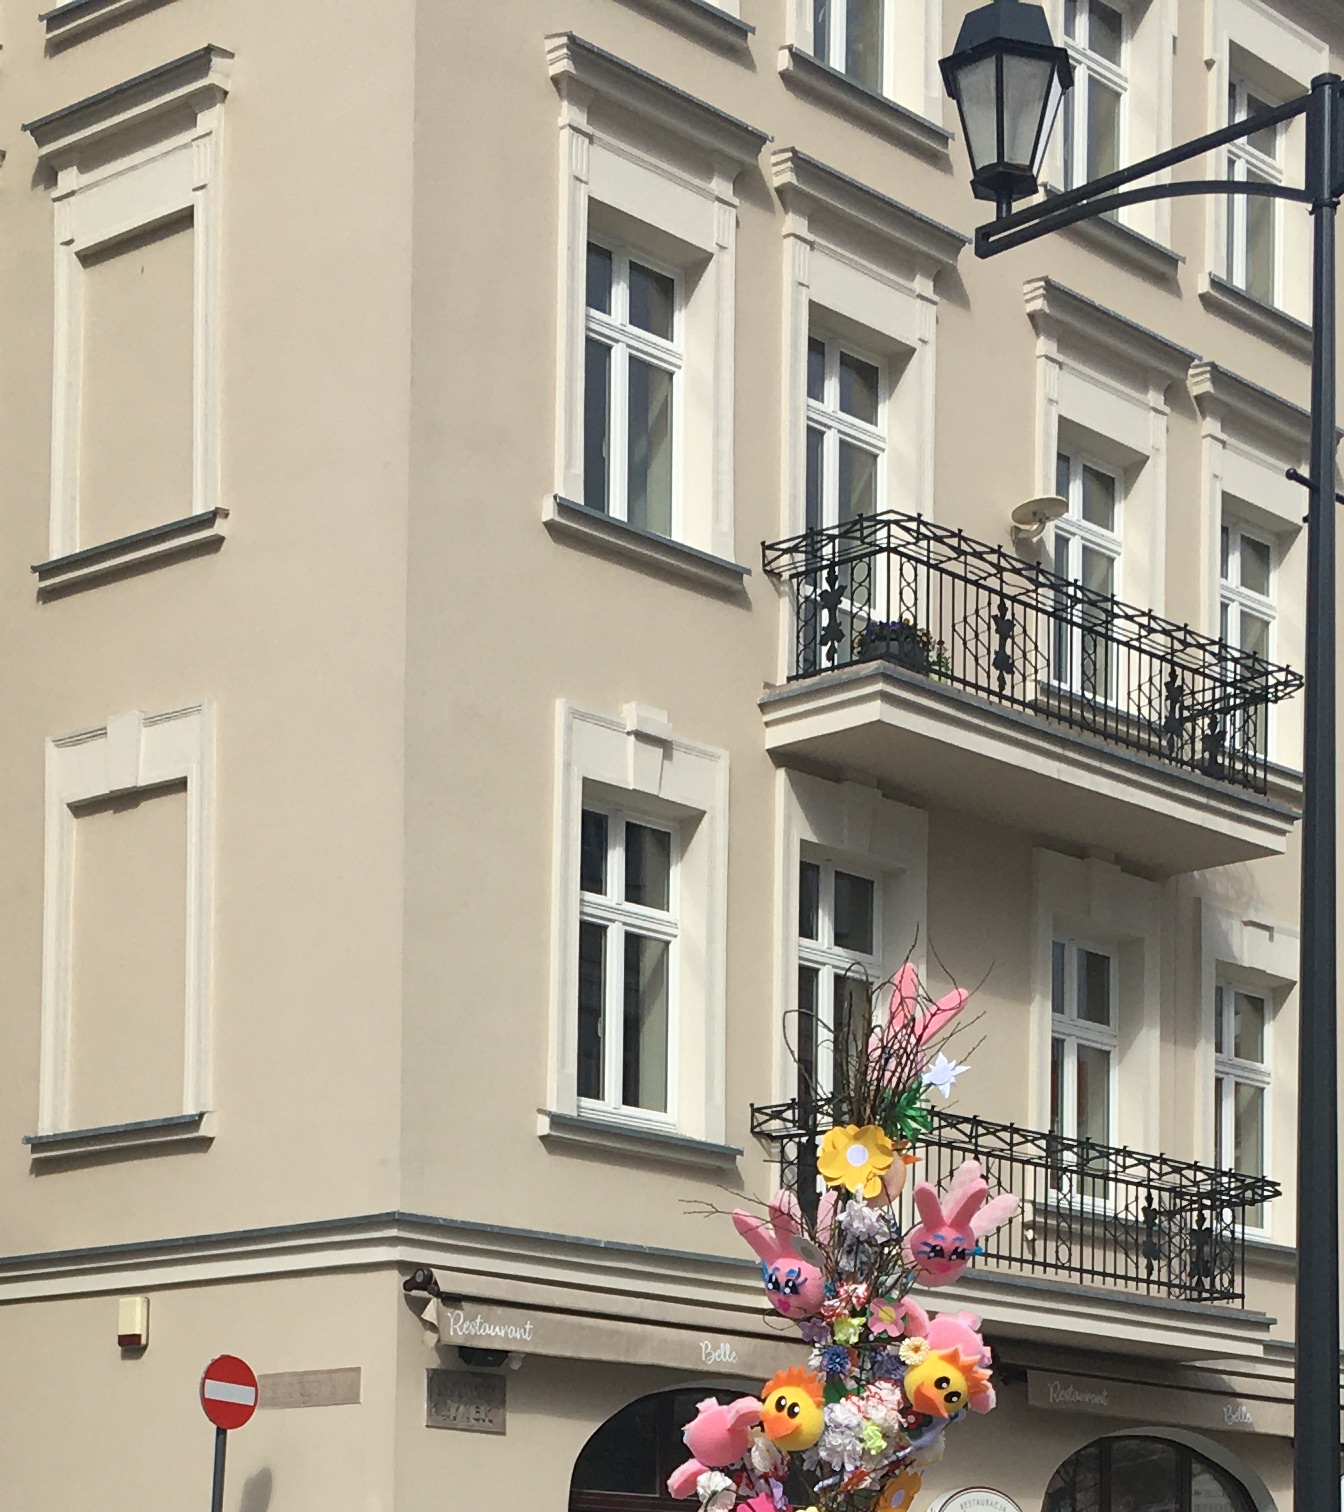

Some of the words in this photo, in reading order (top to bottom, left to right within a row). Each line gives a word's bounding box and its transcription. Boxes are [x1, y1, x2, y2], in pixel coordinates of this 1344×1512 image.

[447, 1311, 534, 1341] Restaurant
[699, 1340, 739, 1365] Belle
[1047, 1380, 1109, 1407] Restaurant
[1222, 1404, 1253, 1425] Belle
